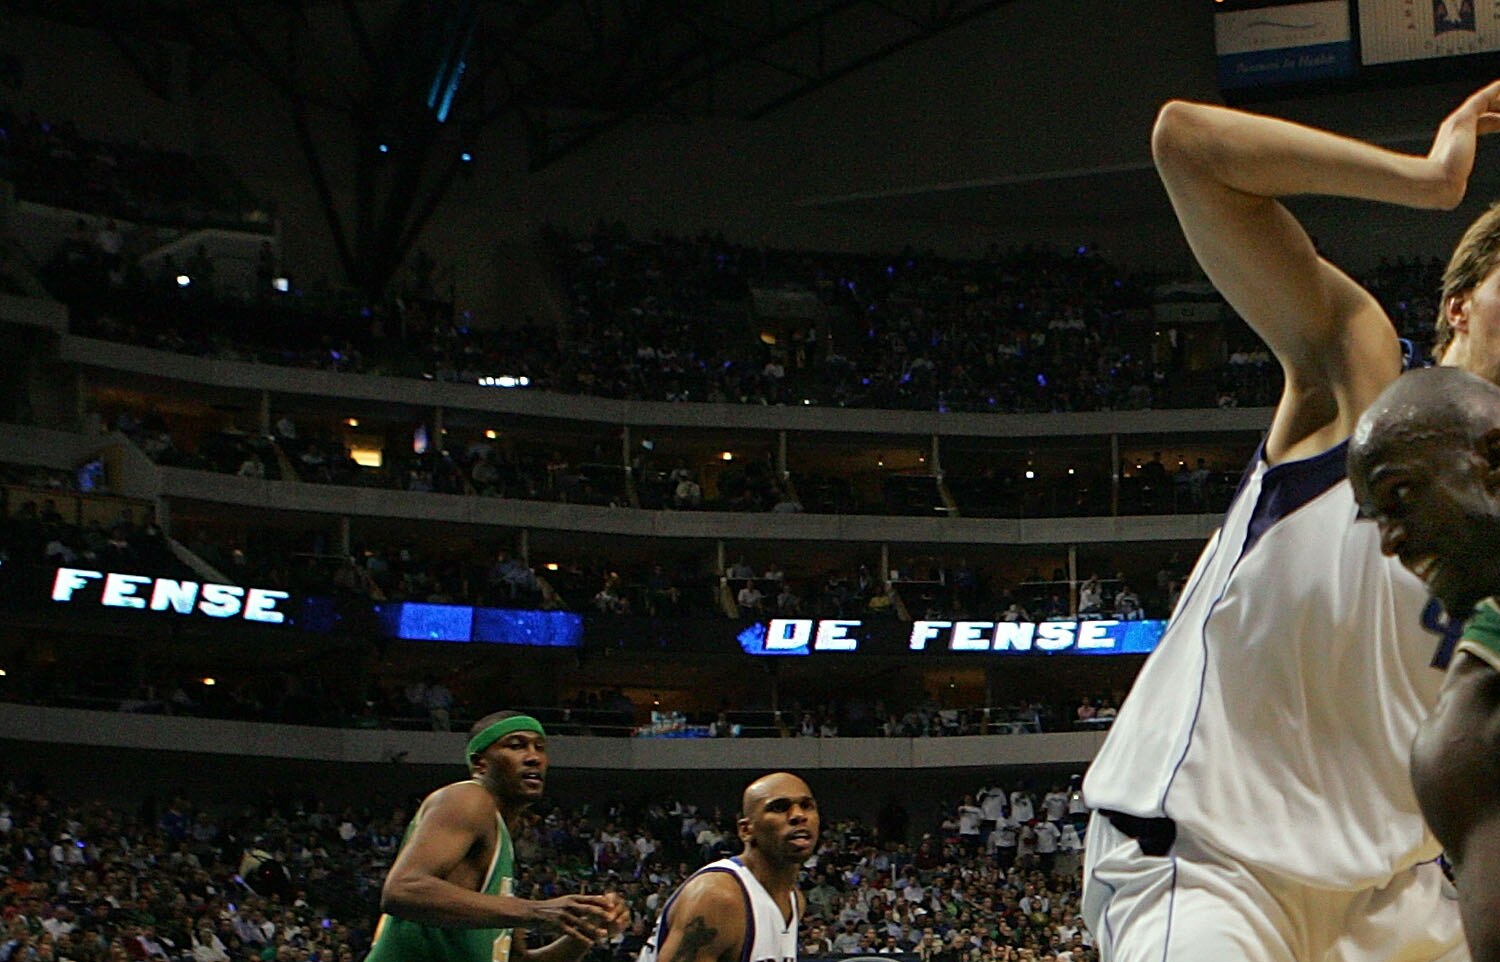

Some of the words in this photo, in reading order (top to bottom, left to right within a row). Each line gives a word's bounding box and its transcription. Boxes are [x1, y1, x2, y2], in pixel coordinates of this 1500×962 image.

[51, 567, 290, 624] FENSE
[764, 618, 862, 650] DE
[908, 620, 1120, 650] FENSE
